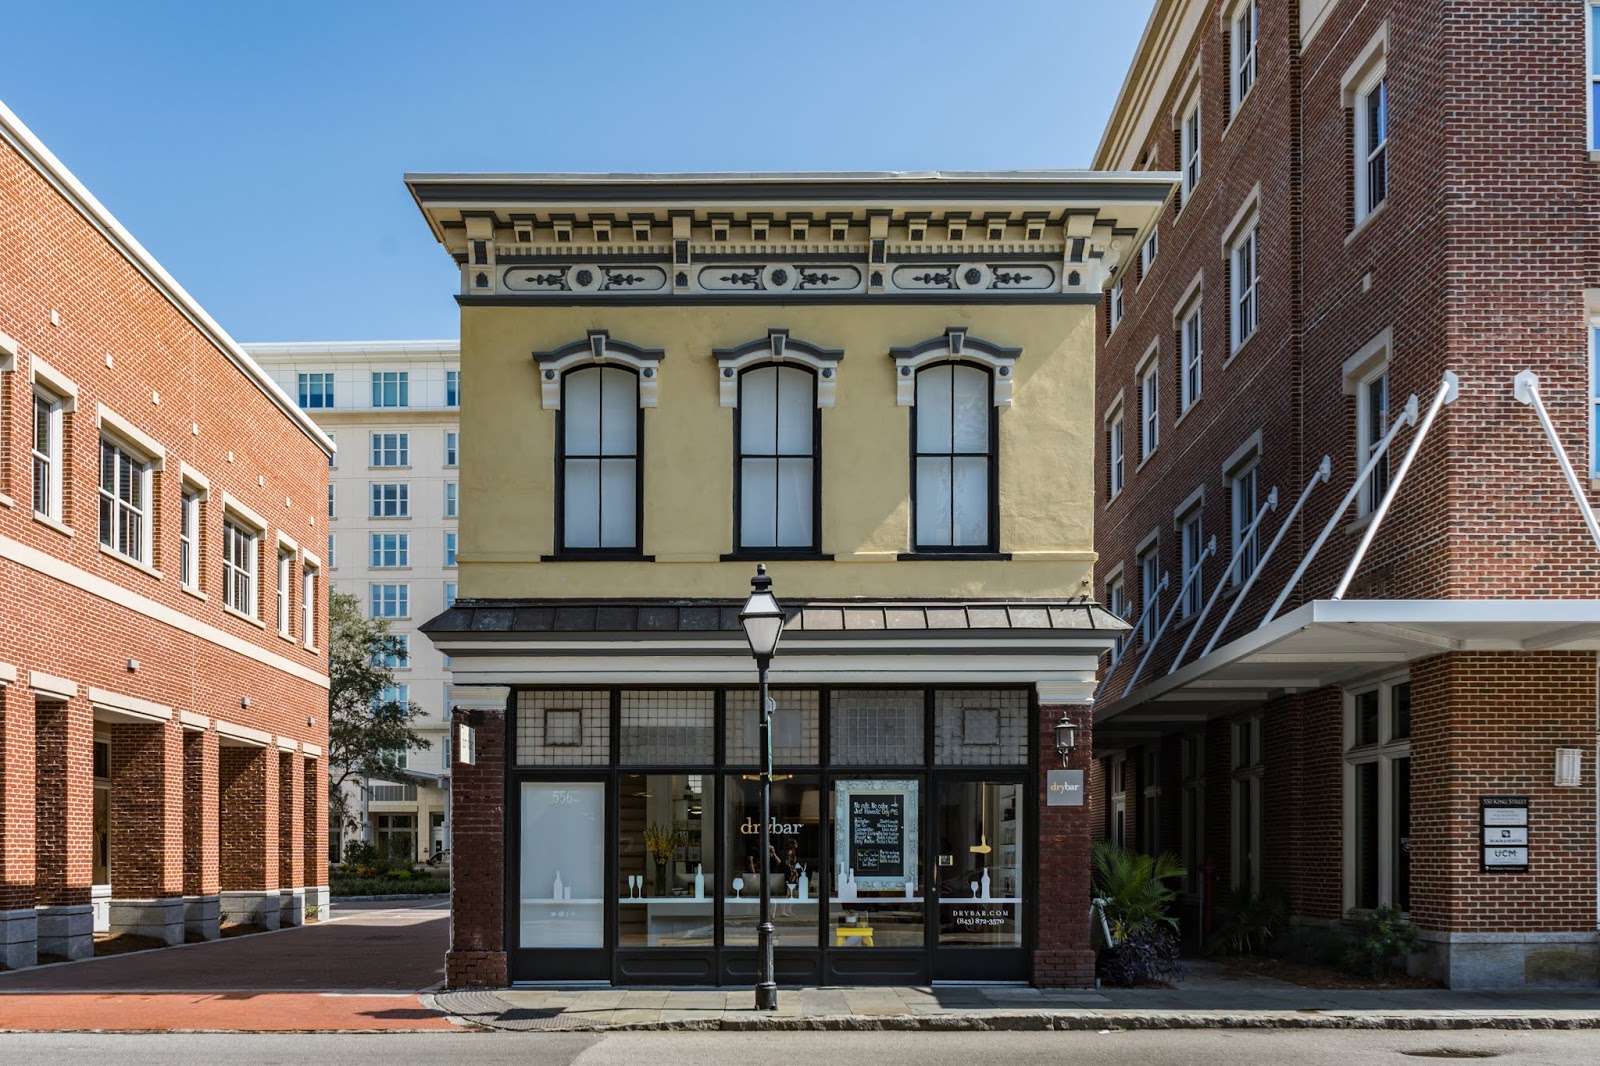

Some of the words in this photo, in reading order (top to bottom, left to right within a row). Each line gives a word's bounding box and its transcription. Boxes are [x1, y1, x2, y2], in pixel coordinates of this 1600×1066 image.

[1050, 781, 1080, 794] drybar
[552, 790, 573, 804] 556
[956, 917, 974, 925] (843)
